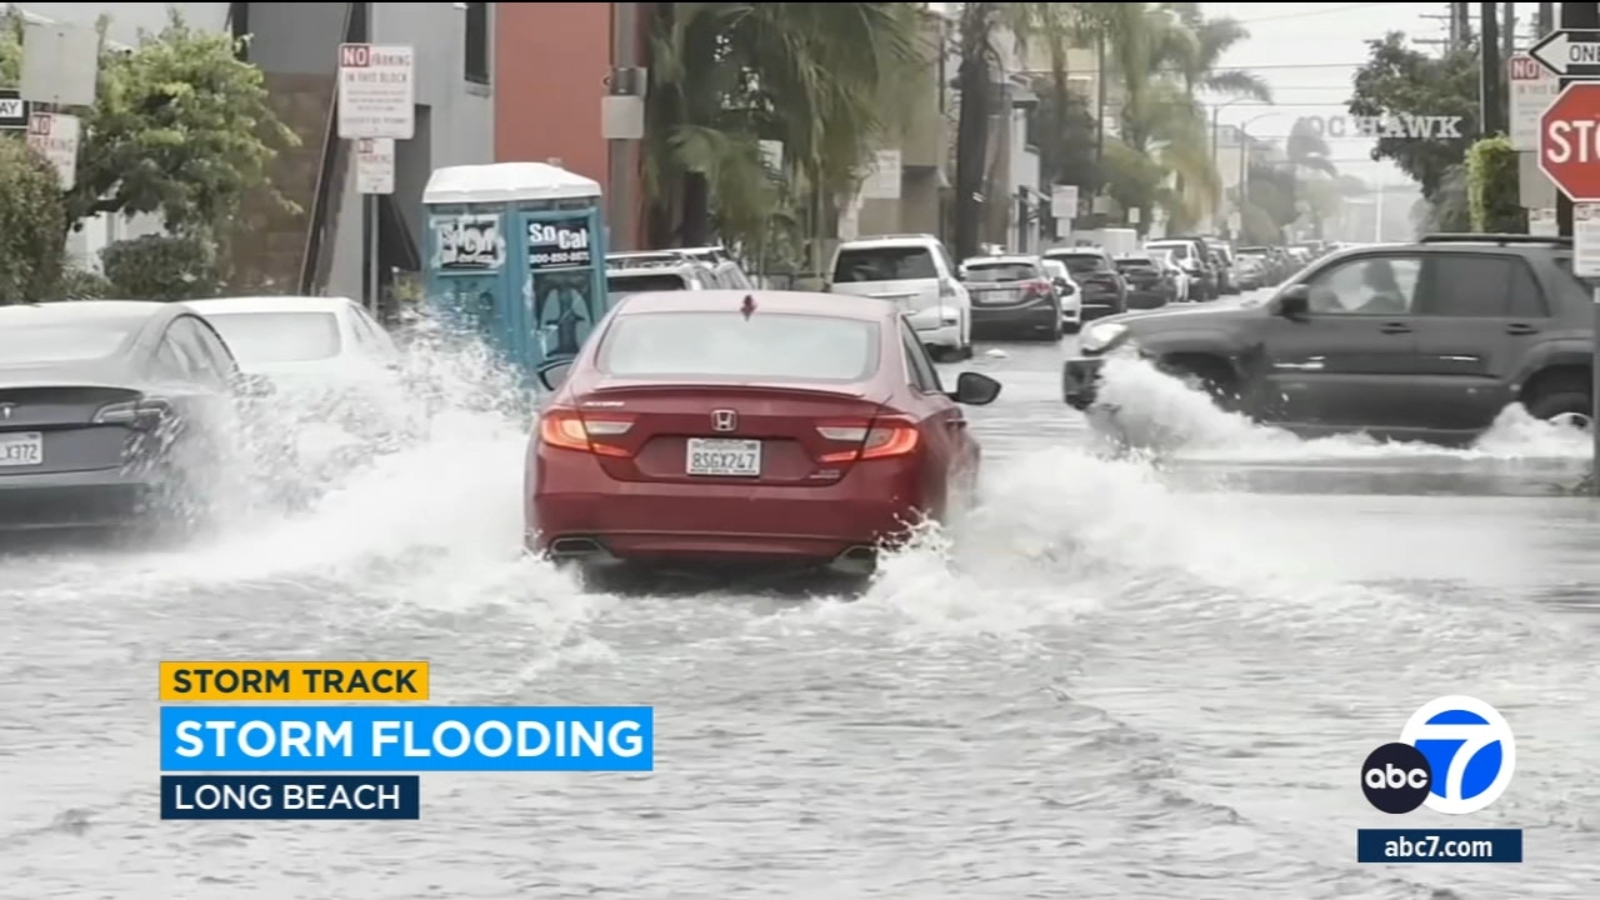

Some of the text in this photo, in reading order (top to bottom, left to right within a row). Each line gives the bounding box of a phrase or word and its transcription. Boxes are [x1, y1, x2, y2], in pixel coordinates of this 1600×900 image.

[344, 47, 367, 66] NO
[1512, 60, 1537, 78] NO
[1547, 120, 1600, 163] ST
[529, 223, 587, 249] So Cal
